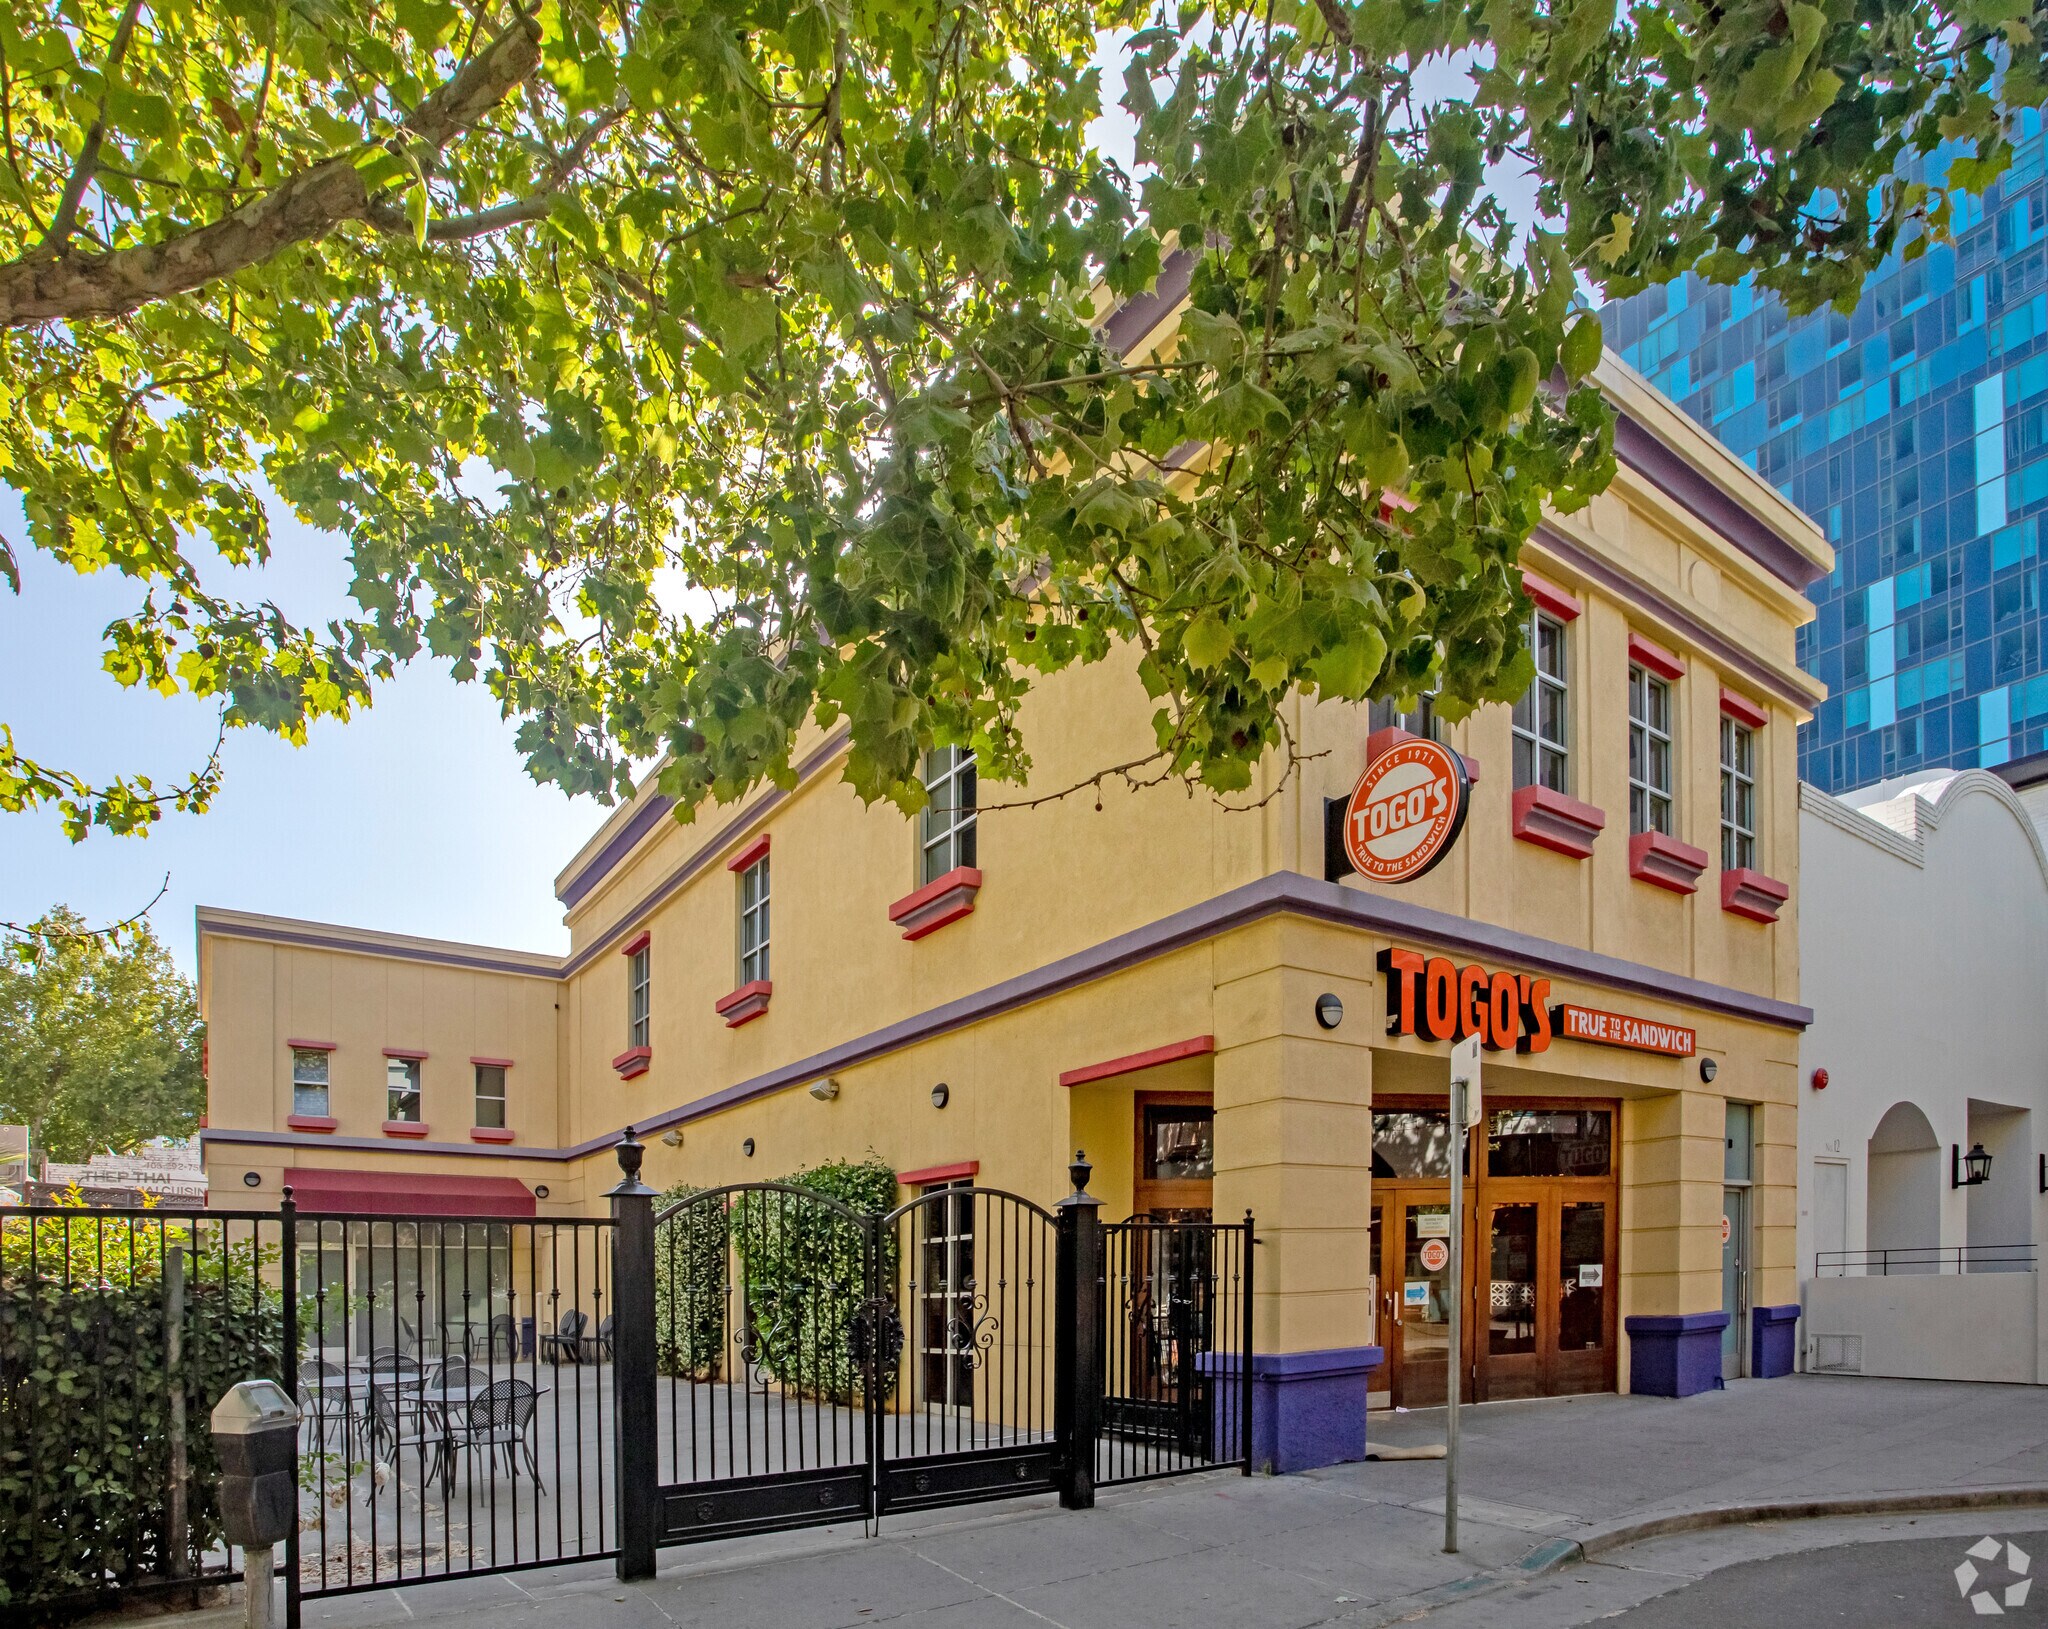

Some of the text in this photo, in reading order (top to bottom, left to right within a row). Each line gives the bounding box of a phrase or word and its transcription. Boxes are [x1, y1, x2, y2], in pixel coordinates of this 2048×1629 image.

[1366, 749, 1435, 789] SINCE 1971
[1352, 776, 1448, 843] TOGO'S
[1356, 816, 1446, 872] TRUE TO THE SANDWICH
[1389, 948, 1552, 1054] TOGO'S
[1568, 1009, 1607, 1038] TRUE
[1609, 1017, 1621, 1029] TO
[1609, 1029, 1621, 1040] THE
[1623, 1020, 1692, 1053] SANDWICH
[132, 1171, 171, 1184] THAI
